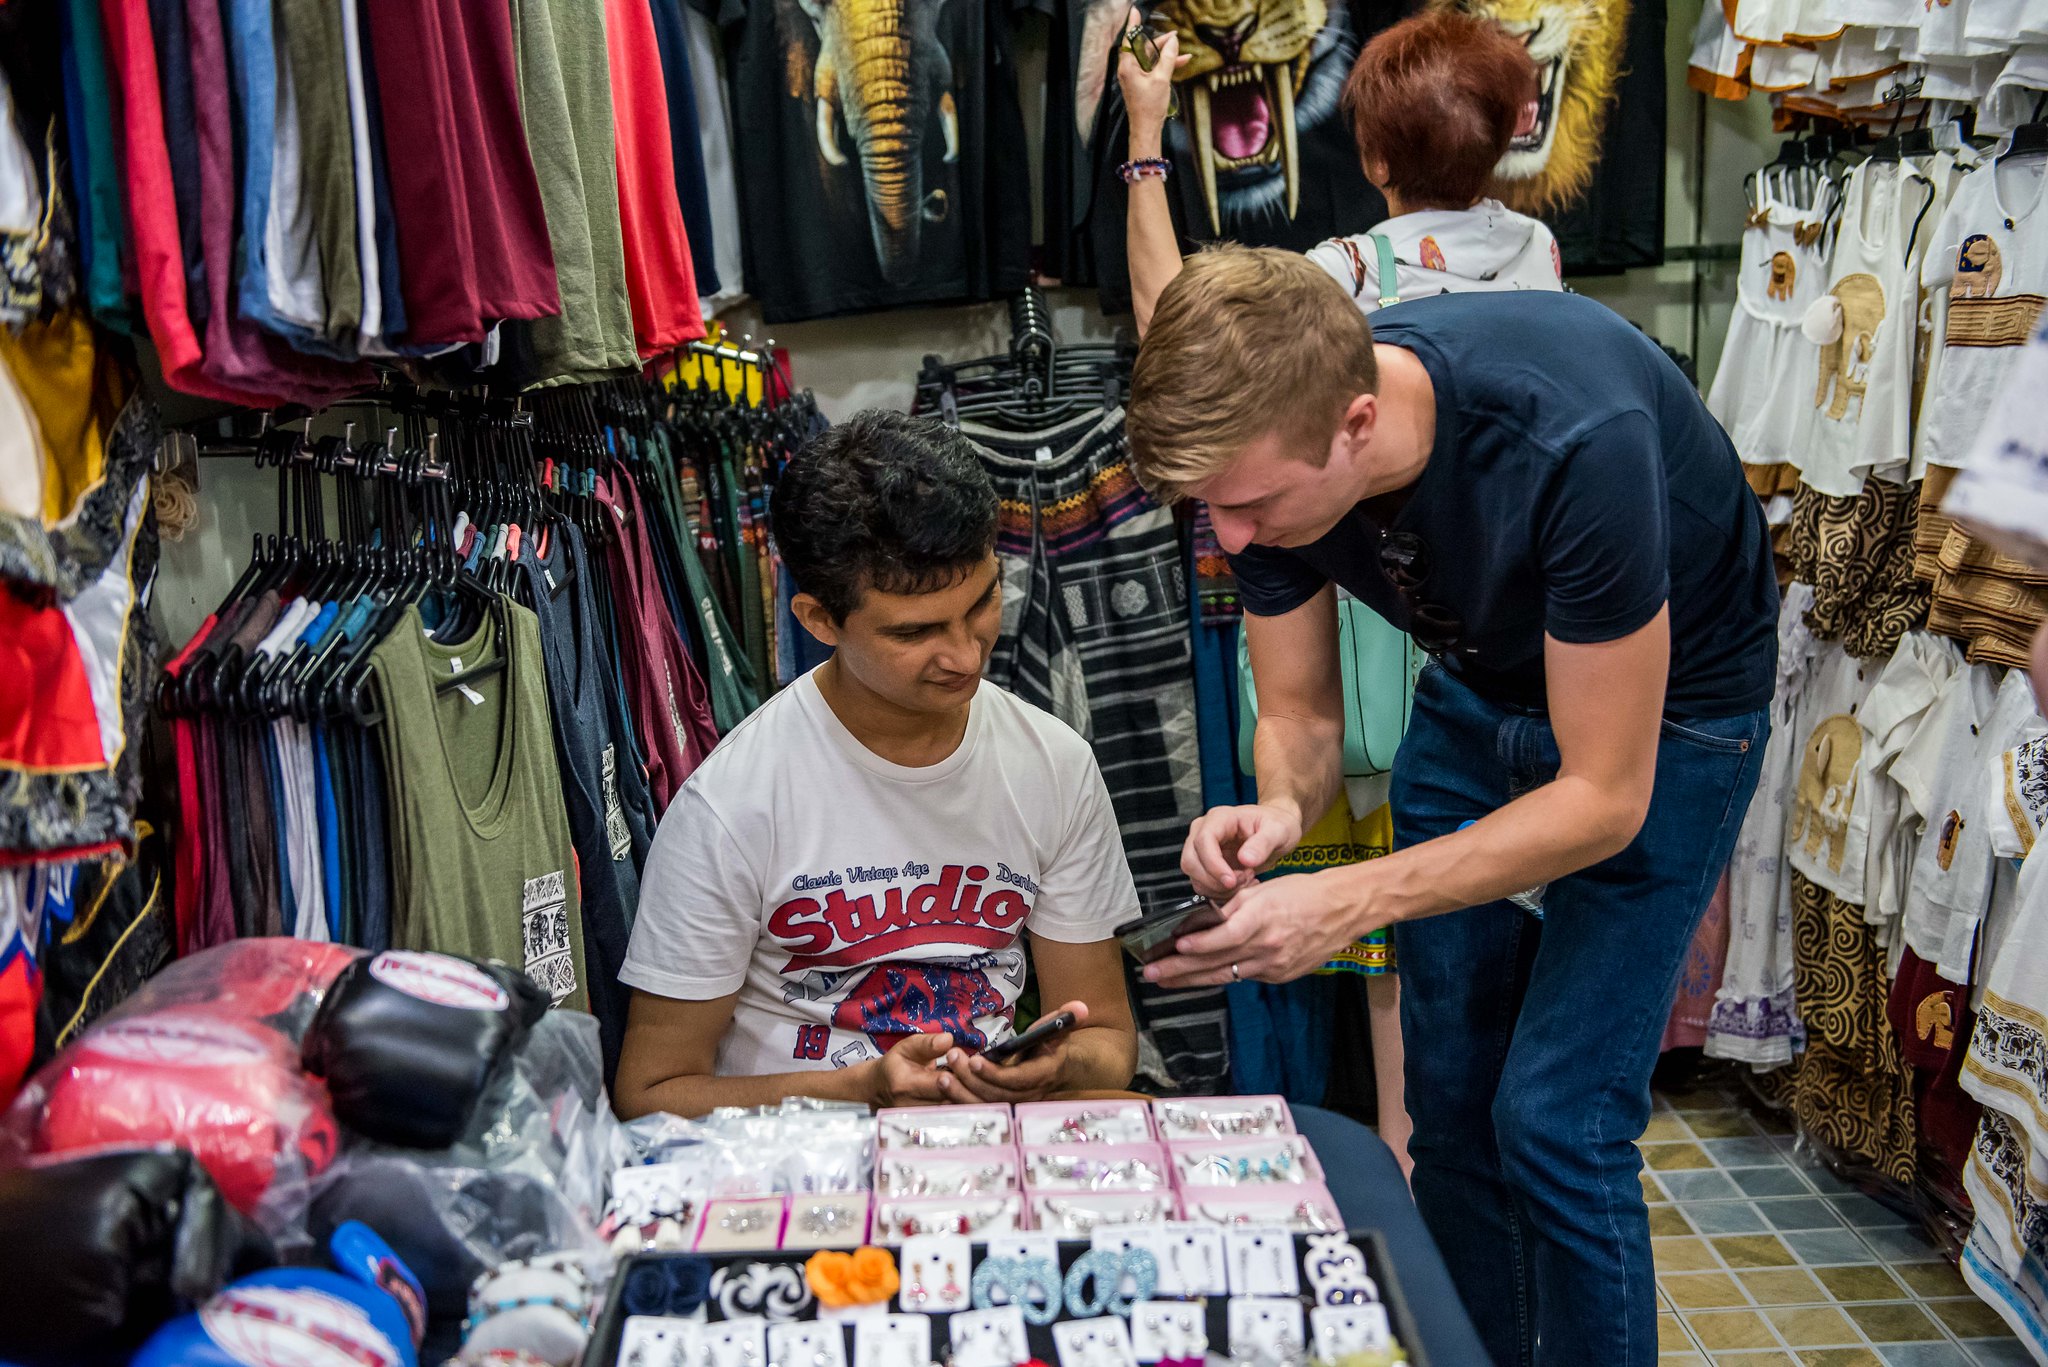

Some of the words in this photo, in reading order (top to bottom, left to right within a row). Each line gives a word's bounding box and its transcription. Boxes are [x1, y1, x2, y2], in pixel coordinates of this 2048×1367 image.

[792, 870, 842, 891] Classic
[847, 865, 898, 883] Vintage
[902, 861, 929, 878] Age
[768, 864, 1032, 954] Studio
[793, 1024, 831, 1060] 19
